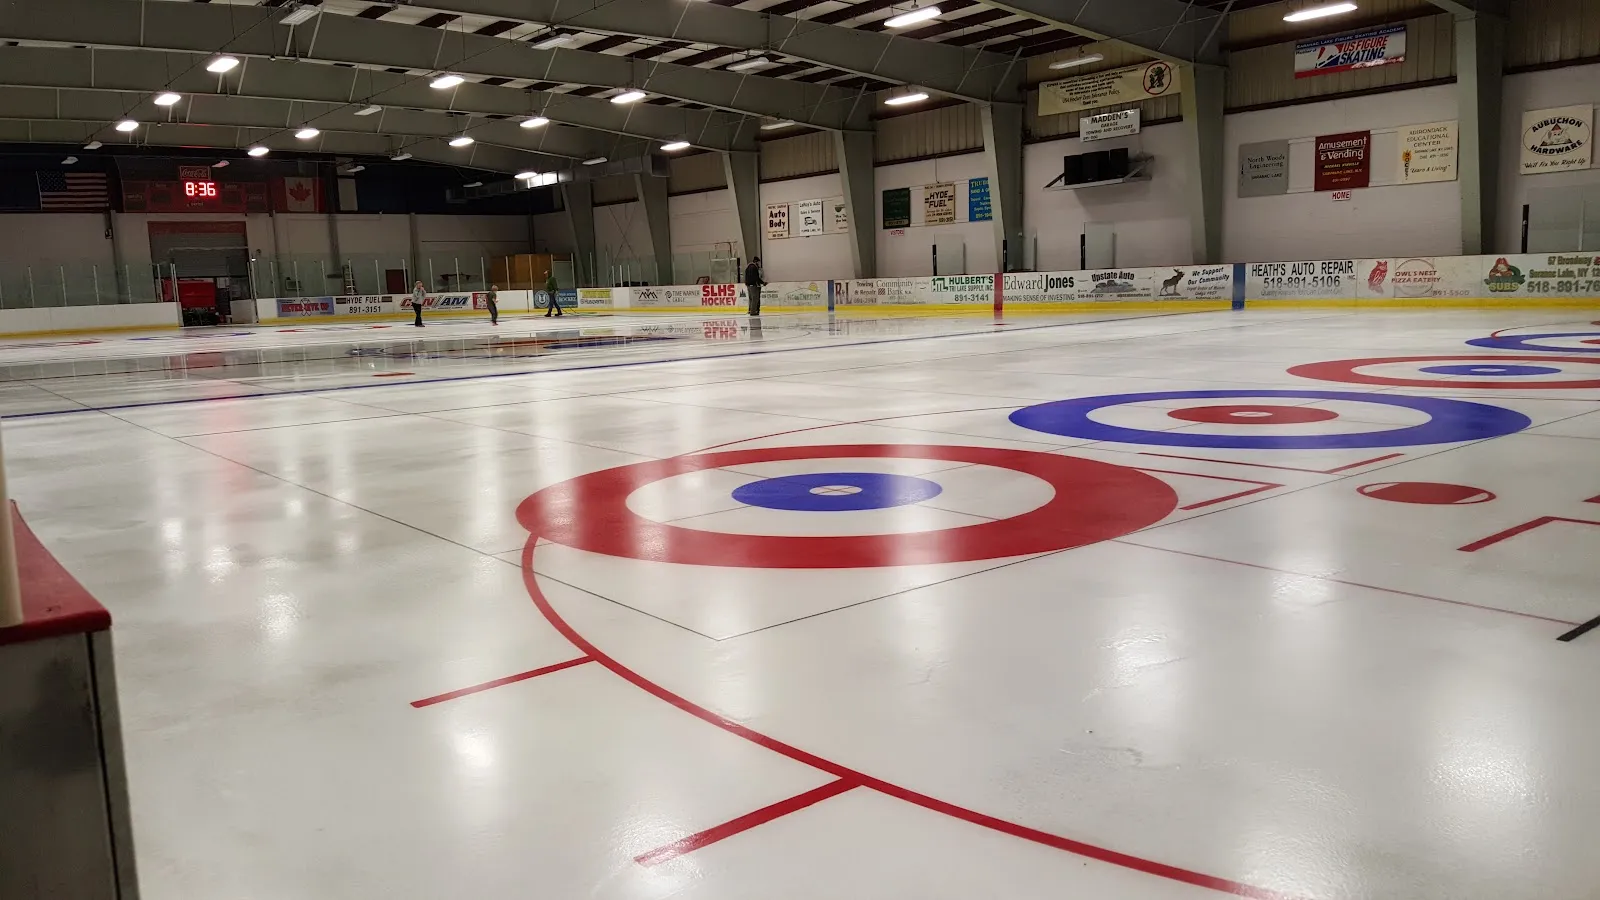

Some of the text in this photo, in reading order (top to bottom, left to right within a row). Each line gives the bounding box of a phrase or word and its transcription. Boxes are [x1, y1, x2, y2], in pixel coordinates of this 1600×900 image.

[1339, 46, 1386, 65] SKATING
[1091, 111, 1129, 124] MADDEN'S
[1532, 117, 1583, 133] AUBUCHON
[1409, 127, 1448, 136] ADIRONDACK
[1406, 133, 1449, 142] EDUCATIONAL
[1318, 136, 1367, 152] Amusement
[1413, 140, 1441, 148] CENTER
[1530, 139, 1583, 154] HARDWARE
[1247, 153, 1285, 164] North Woods
[1327, 149, 1364, 161] Vending
[186, 182, 214, 196] 8:36
[930, 191, 949, 200] HYDE
[1332, 192, 1350, 200] HOME
[929, 200, 947, 208] FUEL
[769, 210, 786, 219] Auto
[769, 219, 786, 230] Body
[1202, 267, 1224, 276] Support
[1252, 260, 1354, 277] HEATH'S AUTO REPAIR
[949, 276, 994, 285] HULBERT'S
[1091, 270, 1135, 282] Upstate Auto
[1199, 273, 1230, 284] Community
[856, 281, 874, 289] Towing
[877, 279, 914, 289] Community
[1003, 274, 1074, 293] Edward Jones
[1263, 276, 1341, 289] 518-891-5106
[1488, 282, 1520, 292] SUBS
[672, 289, 684, 298] TIME
[685, 288, 701, 297] WARNER
[702, 284, 736, 297] SLHS
[887, 287, 902, 295] Bank
[701, 297, 737, 306] HOCKEY
[954, 294, 989, 302] 891-3141
[1048, 293, 1075, 301] INVESTING
[349, 305, 381, 314] 891-3151
